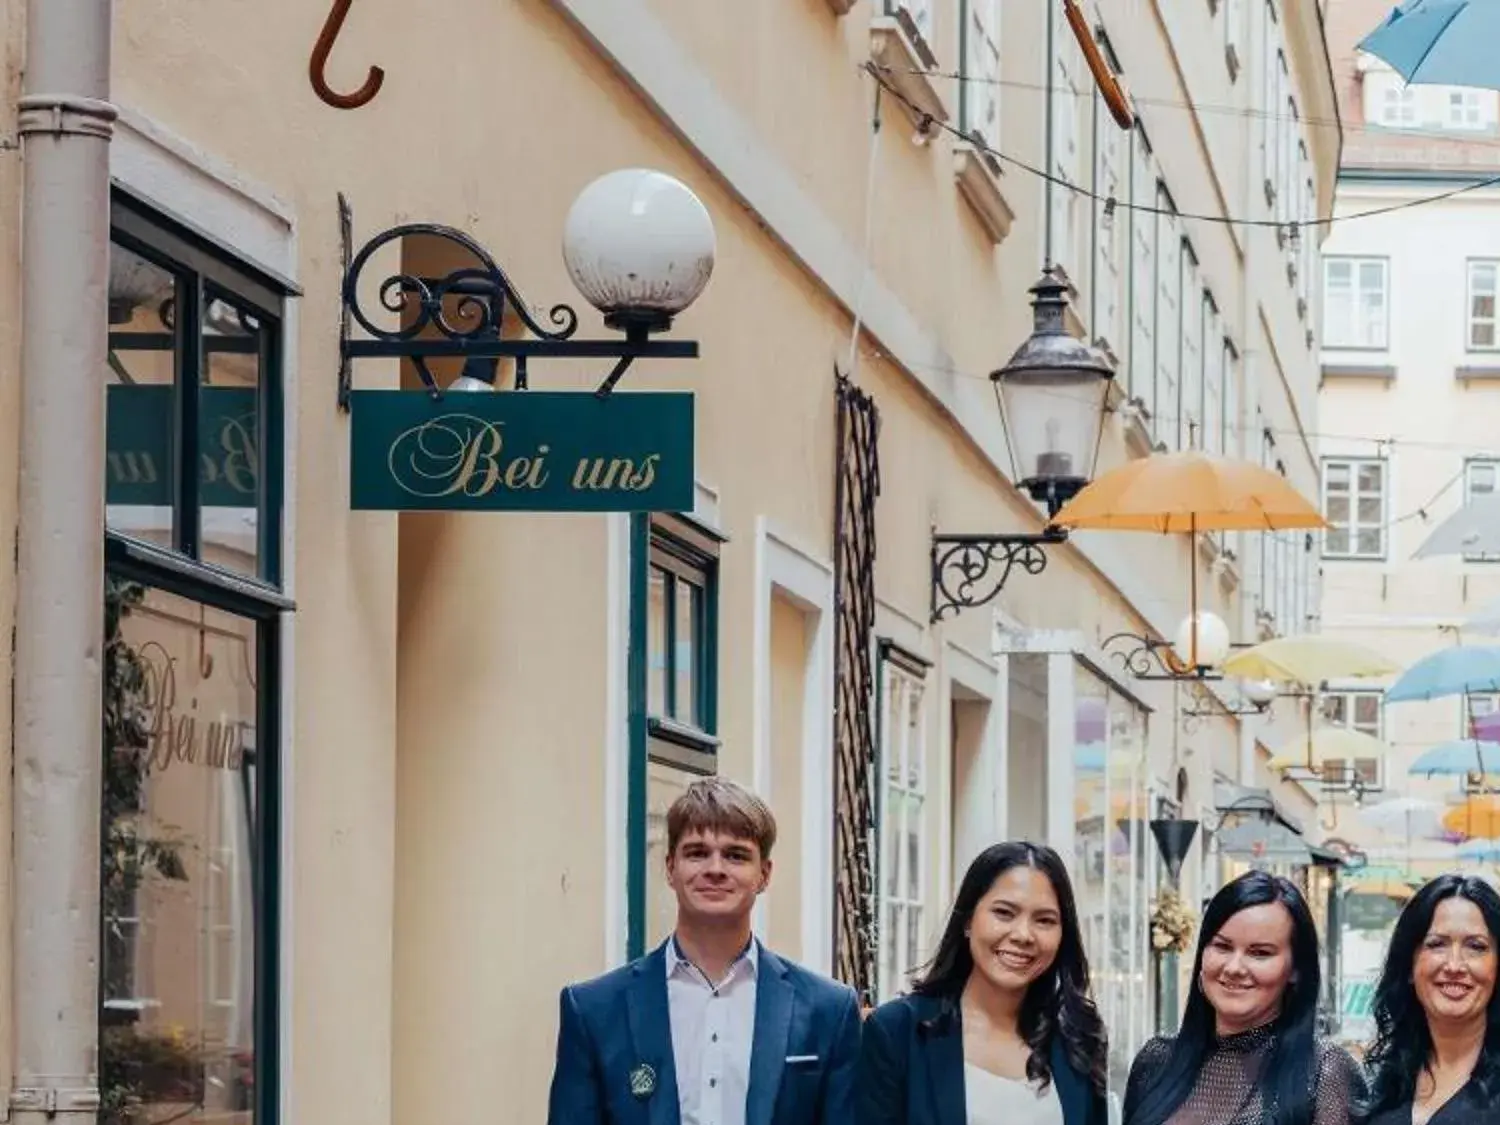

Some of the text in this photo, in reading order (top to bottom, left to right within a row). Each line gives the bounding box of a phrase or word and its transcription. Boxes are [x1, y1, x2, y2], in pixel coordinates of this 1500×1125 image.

[388, 413, 661, 498] Bei uns
[134, 641, 199, 772] Bei
